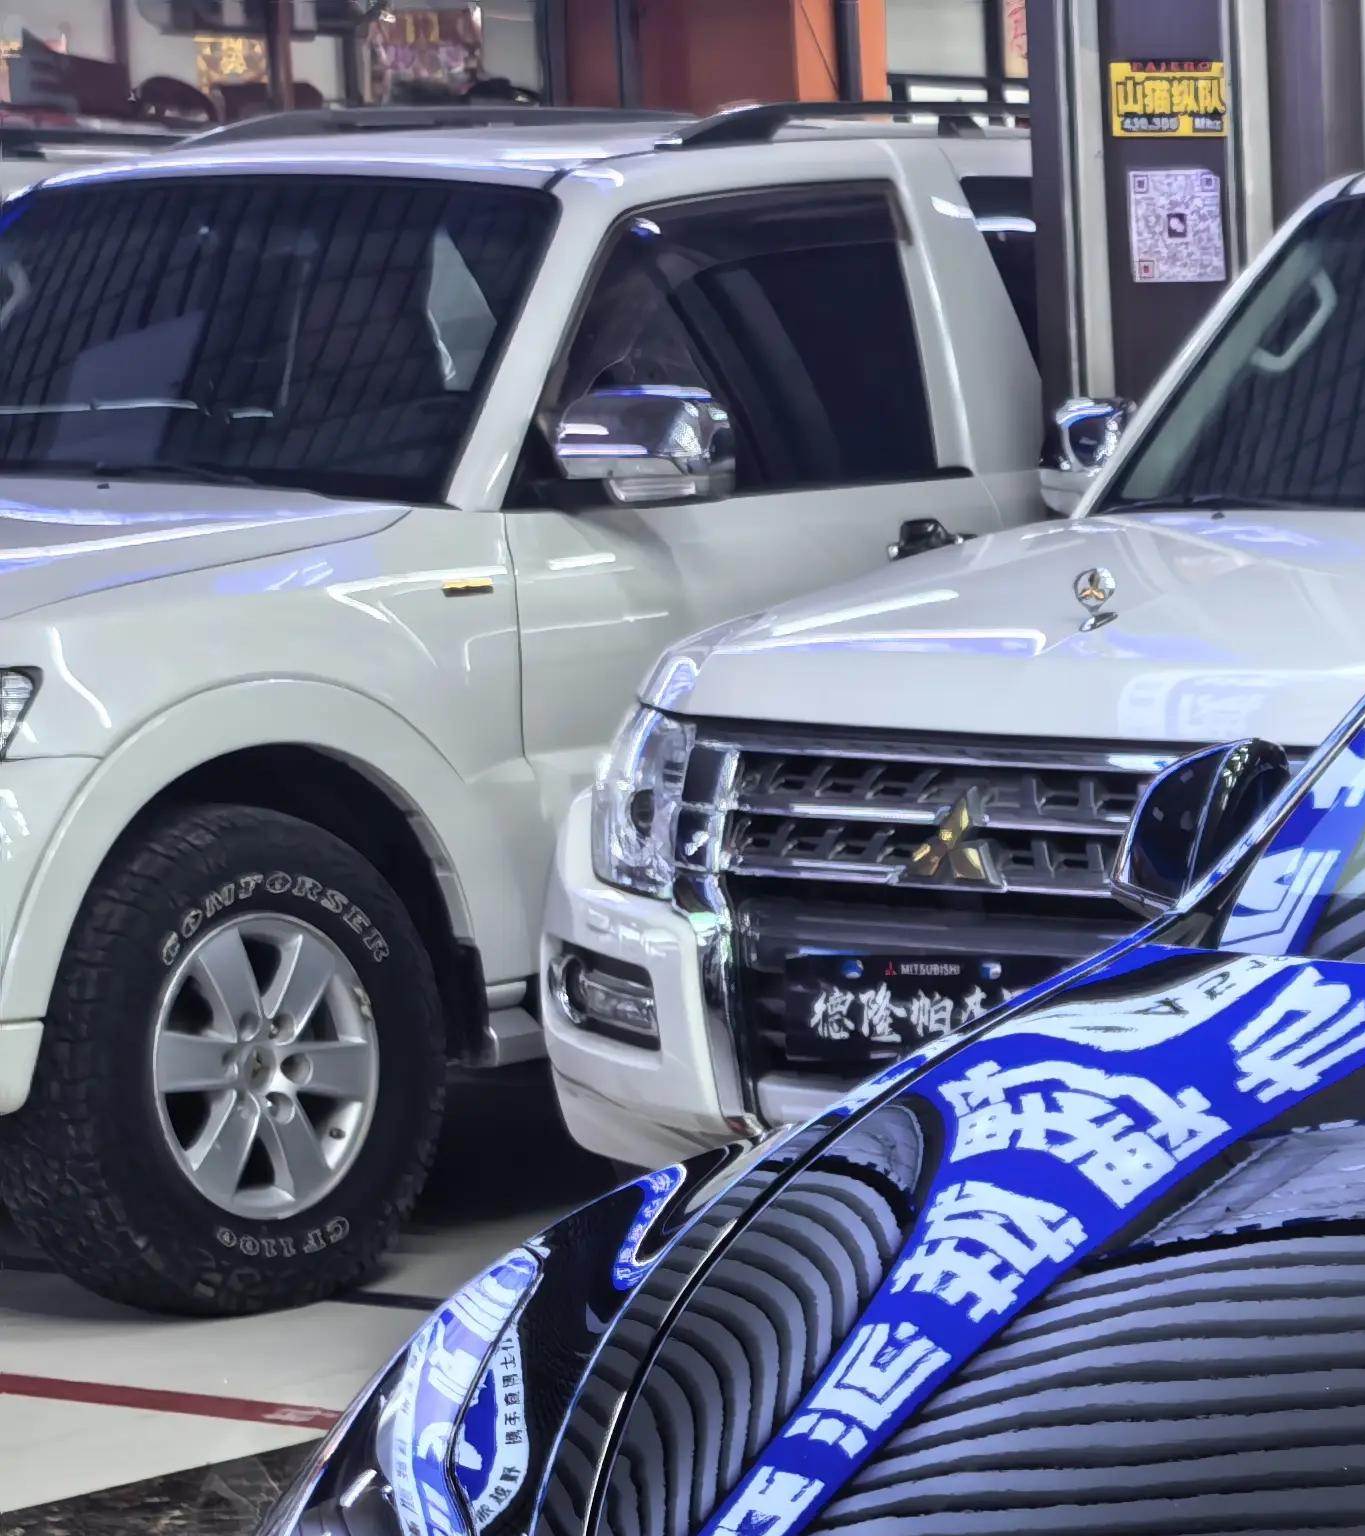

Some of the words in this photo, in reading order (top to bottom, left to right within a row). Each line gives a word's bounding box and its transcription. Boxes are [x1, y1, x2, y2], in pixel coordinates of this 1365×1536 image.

[162, 870, 390, 966] COMFORSER
[900, 963, 961, 976] MITSUBISHI
[810, 982, 1027, 1042] 德隆帕杰
